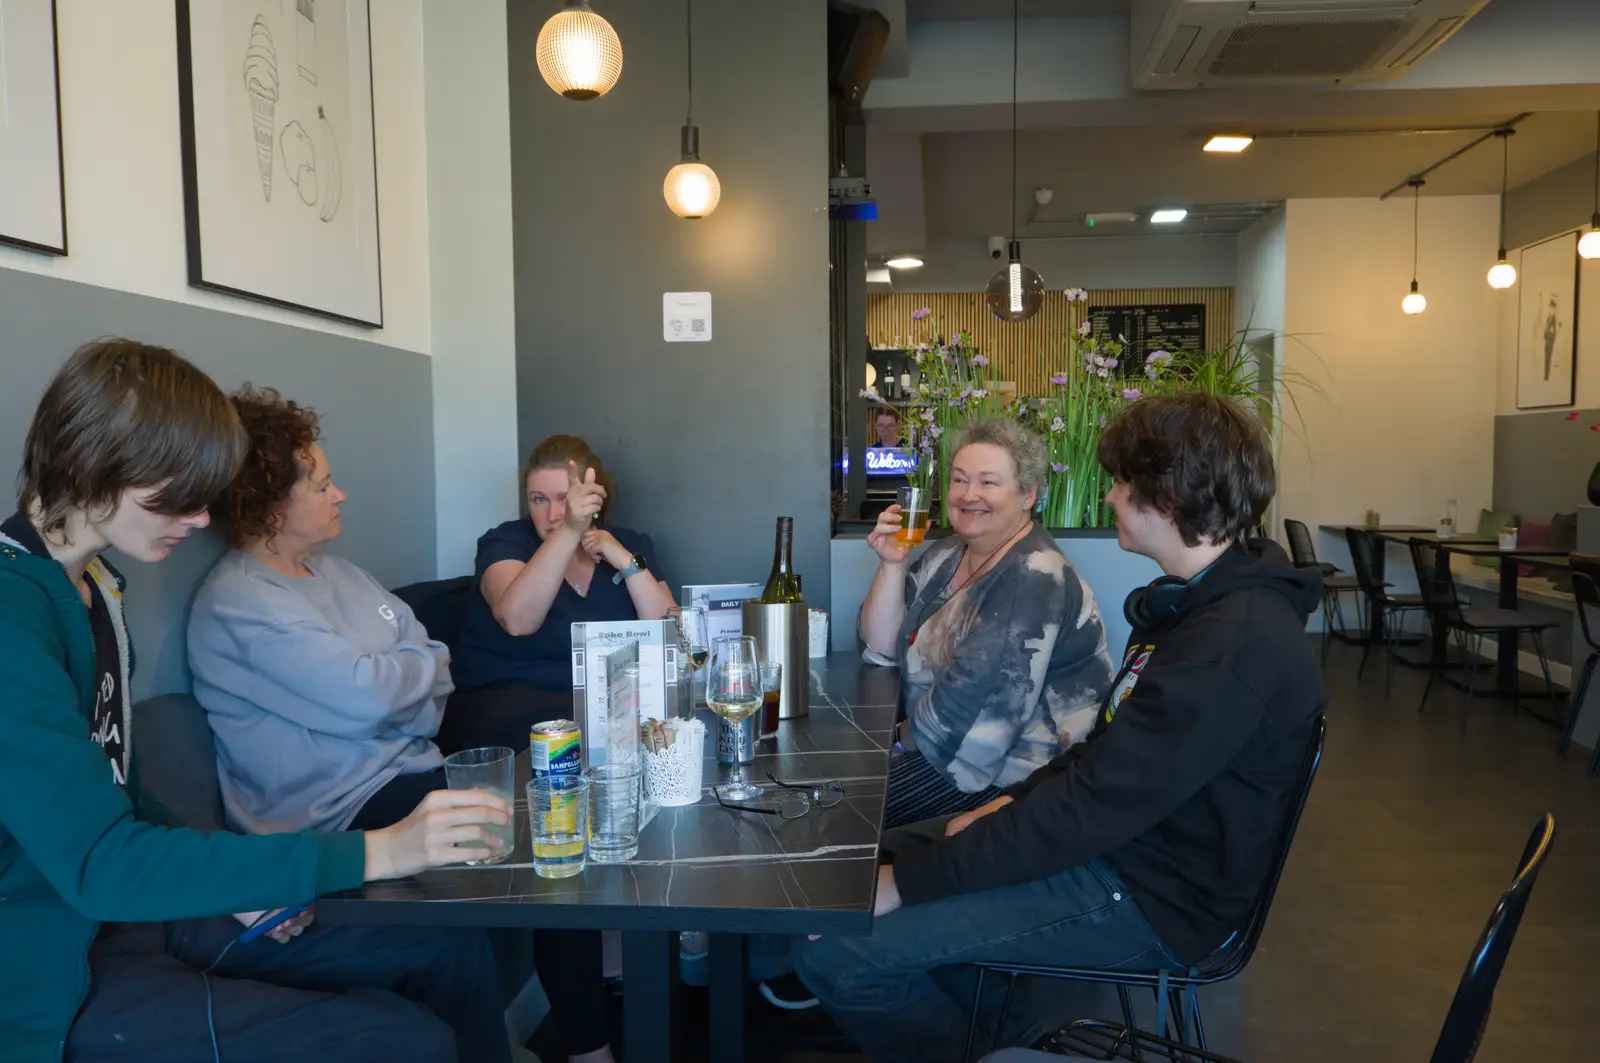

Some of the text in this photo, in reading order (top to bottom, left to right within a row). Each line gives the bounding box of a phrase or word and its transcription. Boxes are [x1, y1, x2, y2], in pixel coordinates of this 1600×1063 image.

[598, 630, 651, 639] Poke Bowl
[720, 724, 743, 734] Ths
[719, 744, 746, 754] tase
